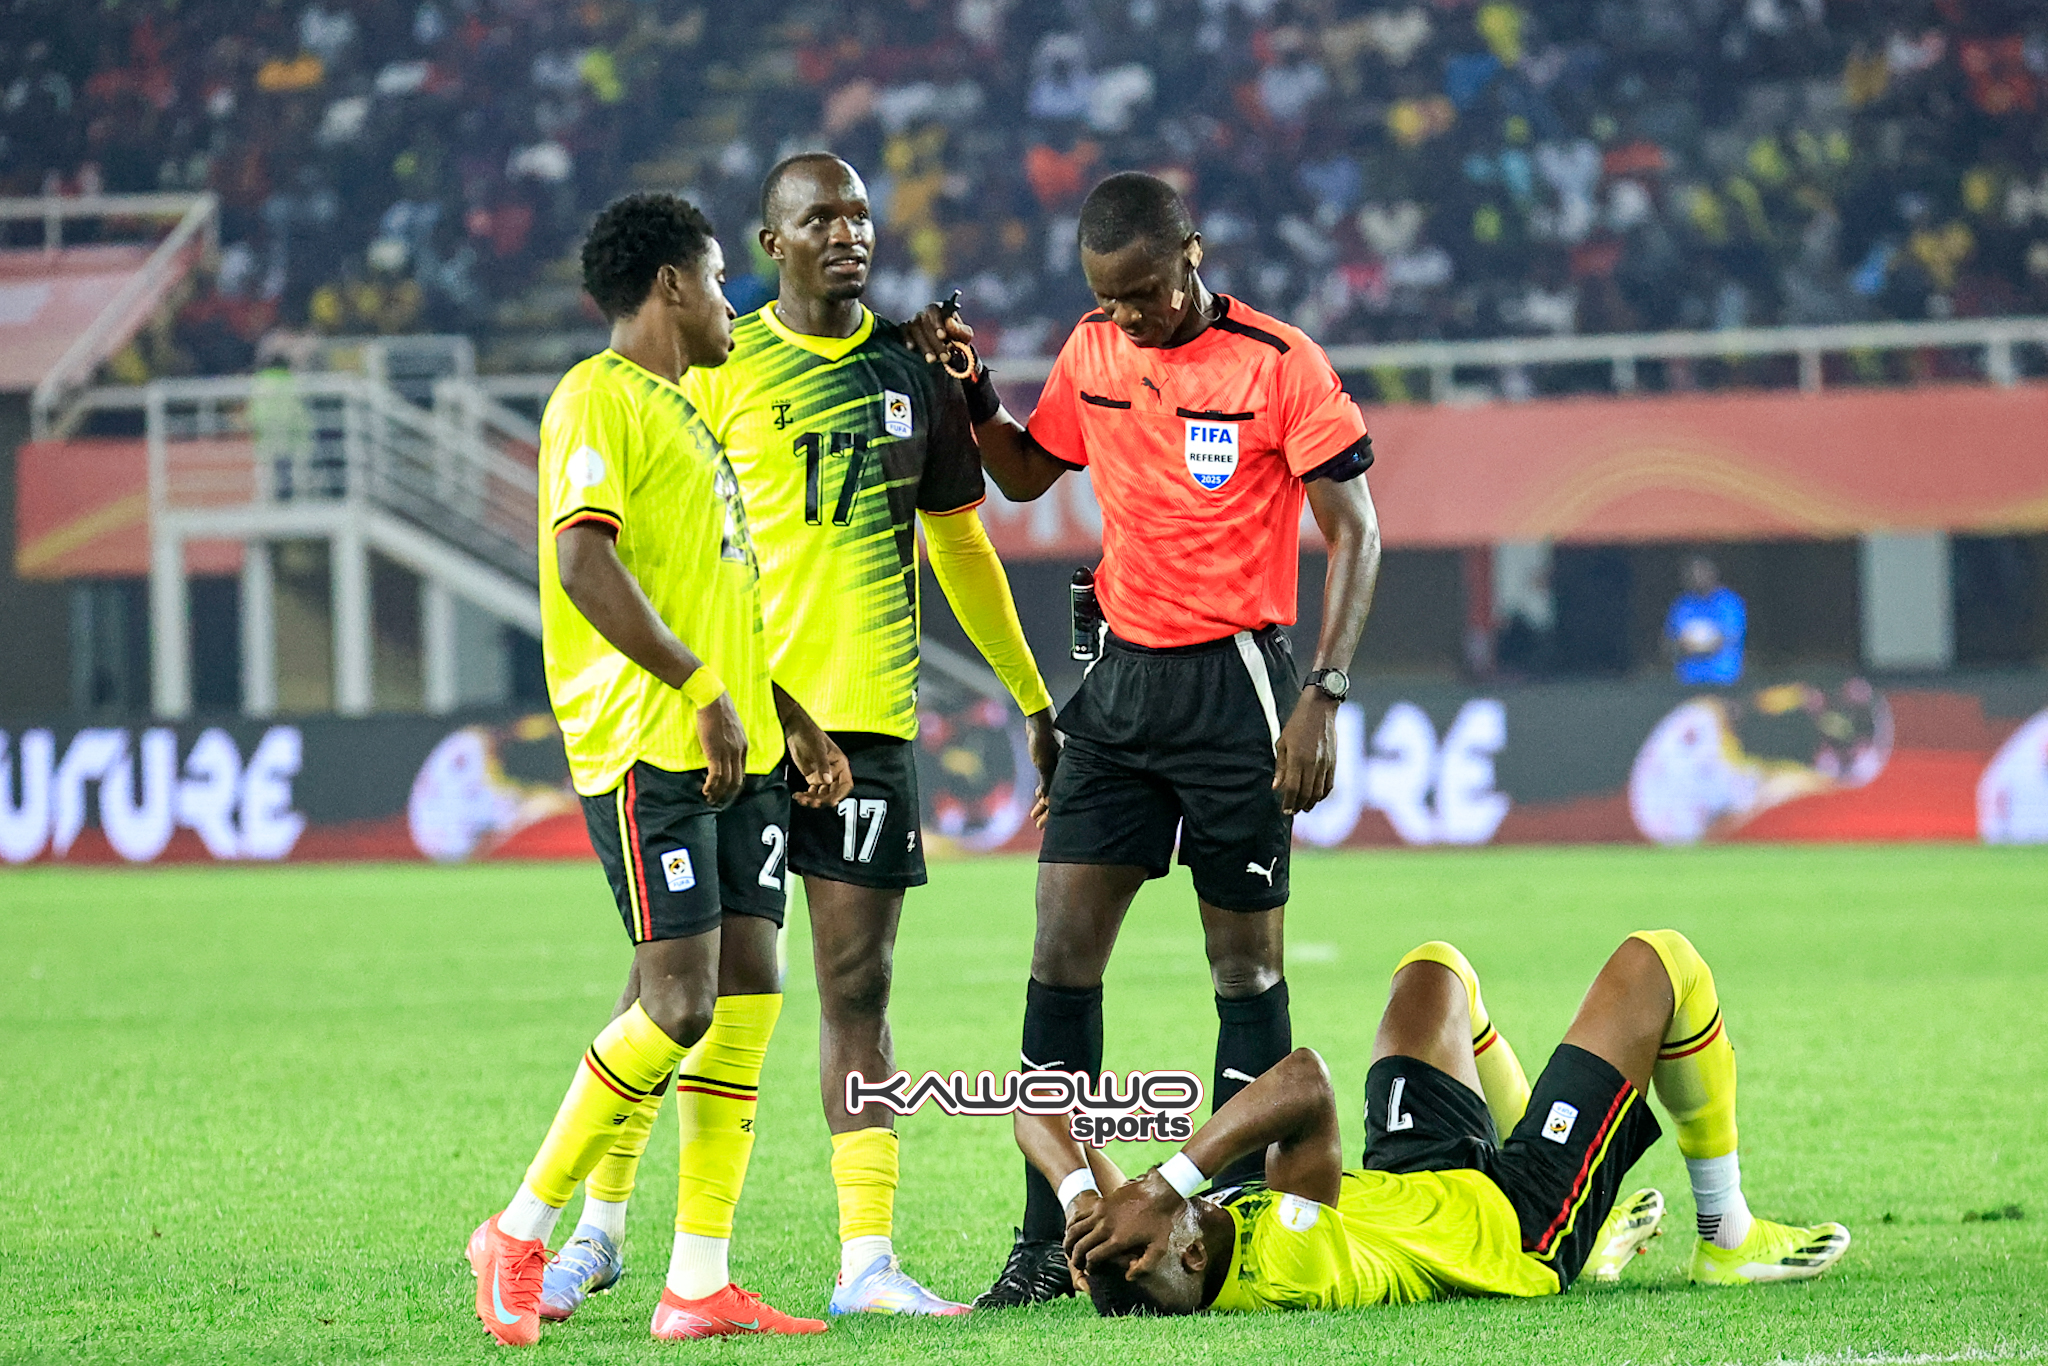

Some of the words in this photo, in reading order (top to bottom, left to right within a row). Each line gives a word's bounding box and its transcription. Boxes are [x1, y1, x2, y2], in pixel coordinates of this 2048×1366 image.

[1190, 426, 1233, 444] FIFA
[1190, 452, 1233, 463] REFEREE
[793, 431, 868, 527] 17
[1200, 474, 1222, 485] 2025
[837, 797, 888, 863] 17
[1386, 1076, 1415, 1133] 7
